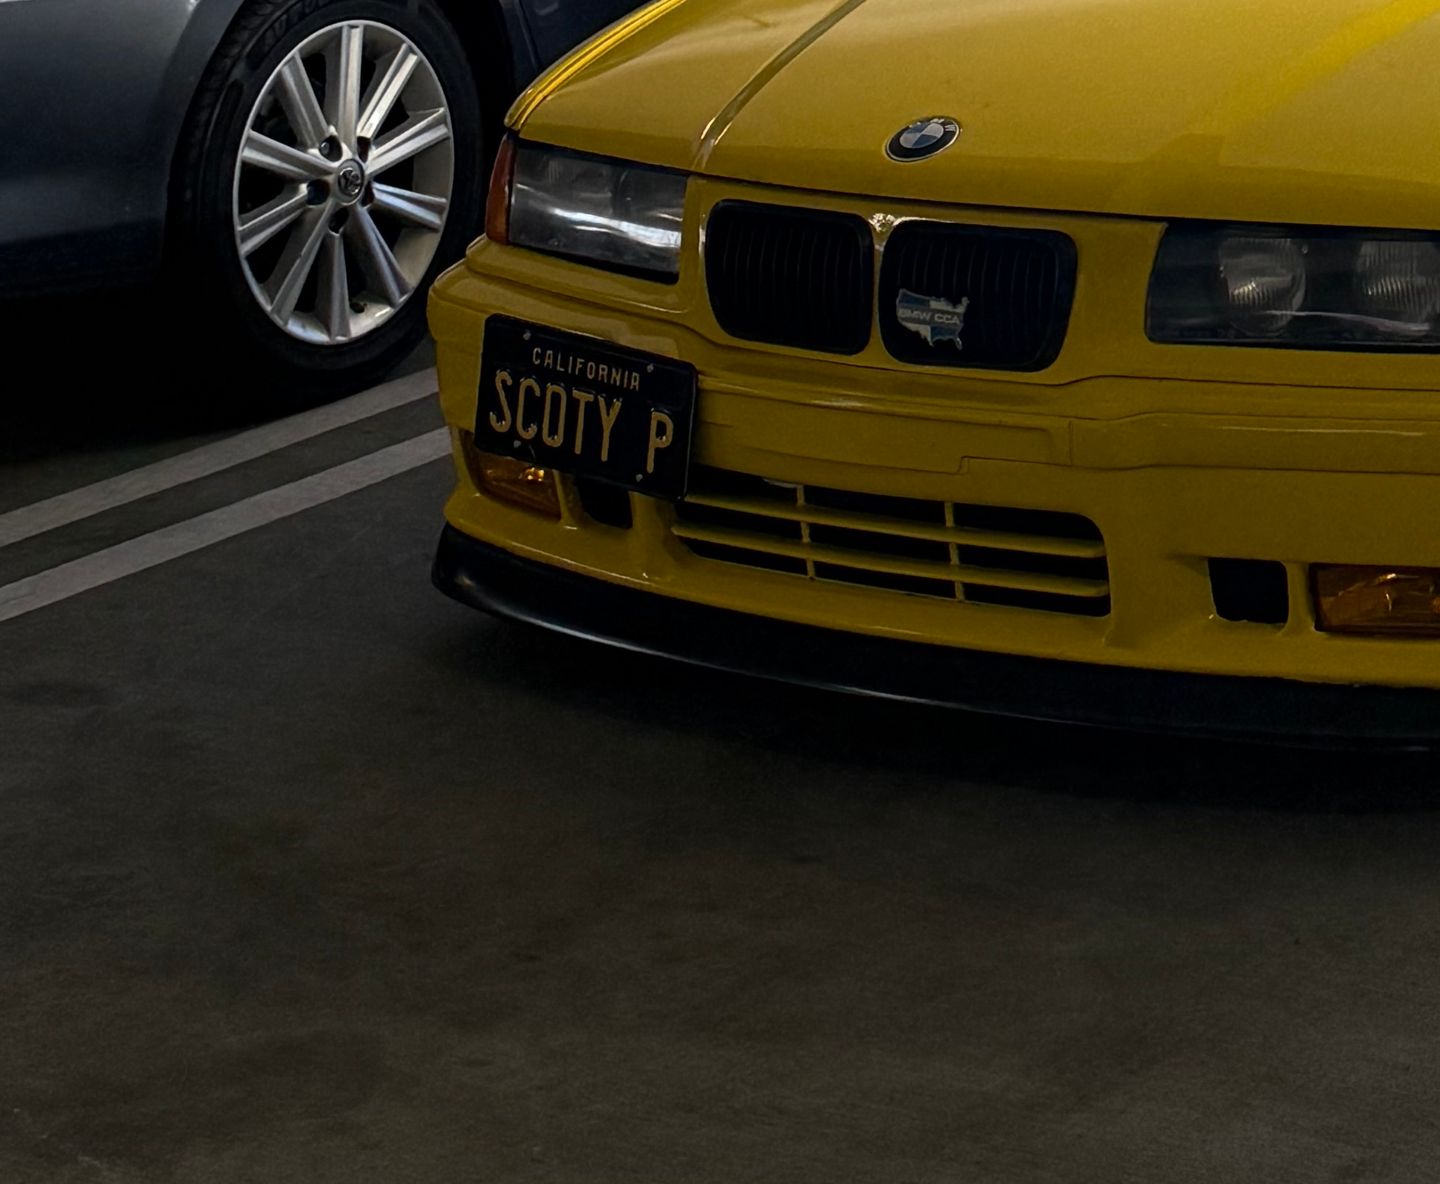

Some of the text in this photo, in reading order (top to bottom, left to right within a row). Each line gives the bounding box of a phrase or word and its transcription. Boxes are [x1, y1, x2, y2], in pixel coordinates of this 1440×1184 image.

[934, 313, 961, 325] CCA
[532, 346, 641, 392] CALIFORNIA
[489, 368, 675, 474] SCOTY P
